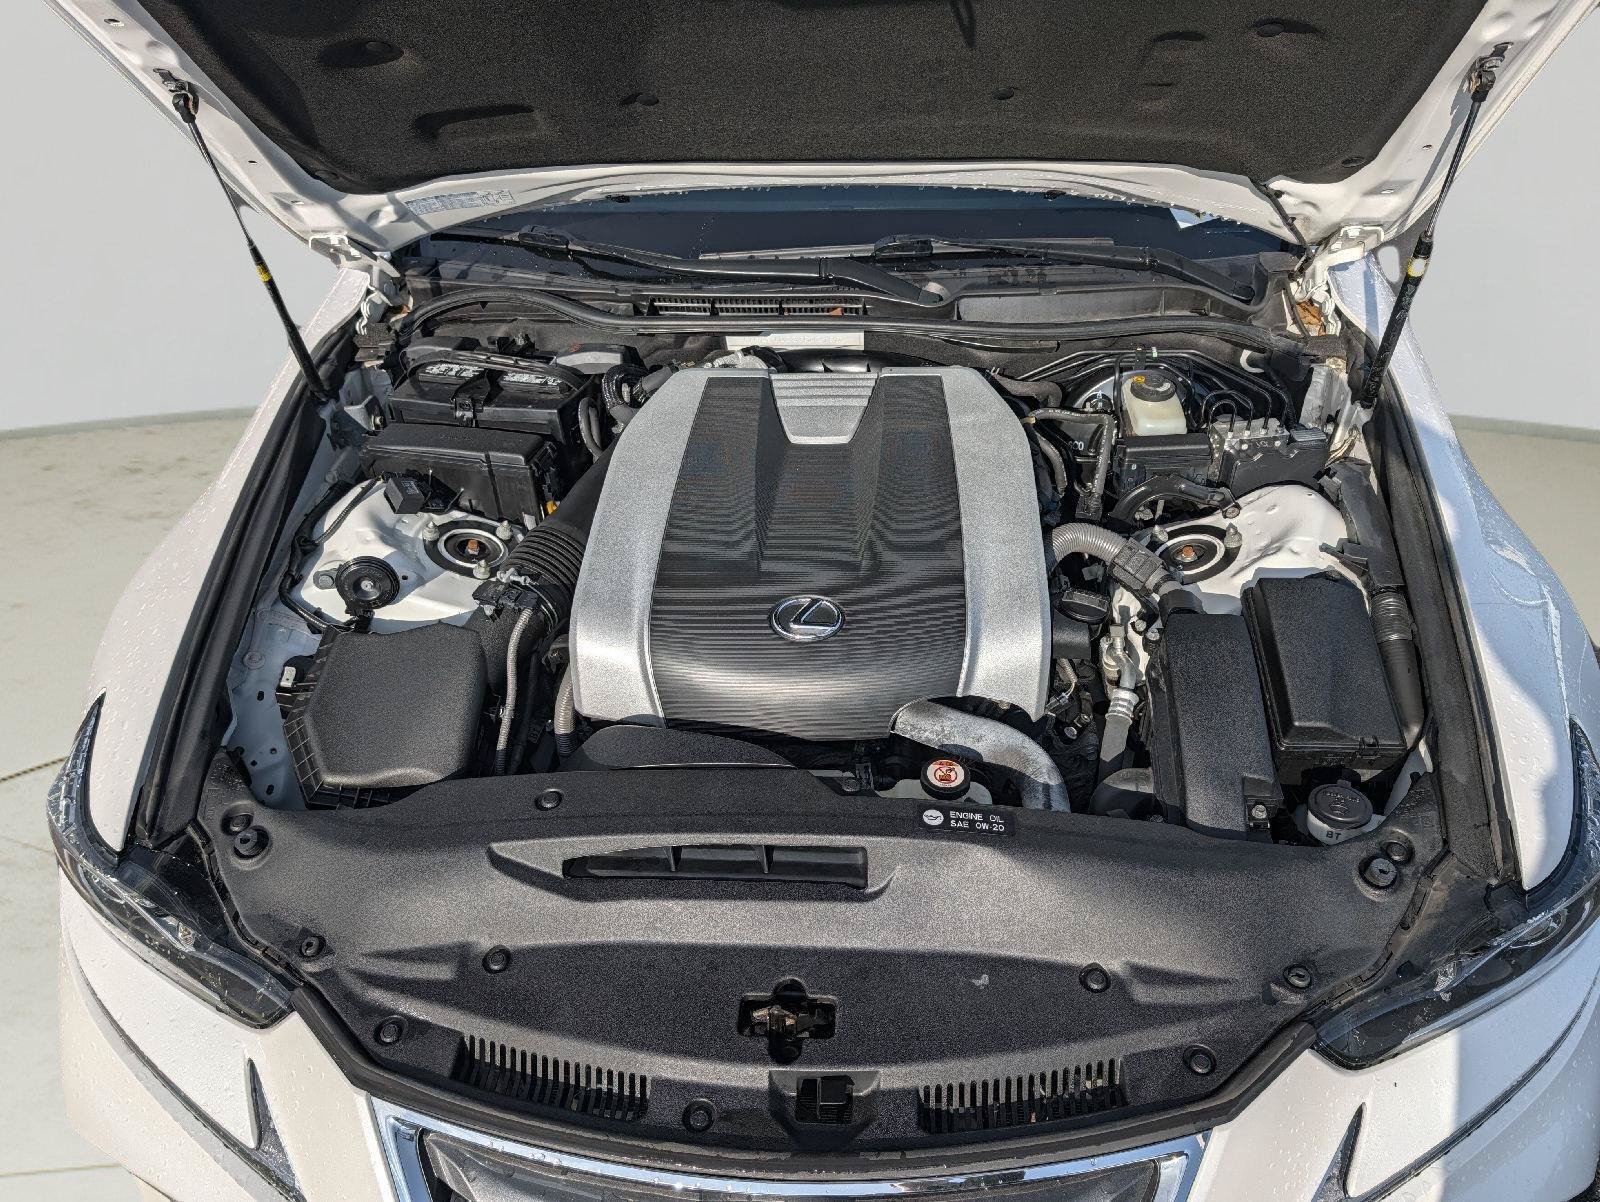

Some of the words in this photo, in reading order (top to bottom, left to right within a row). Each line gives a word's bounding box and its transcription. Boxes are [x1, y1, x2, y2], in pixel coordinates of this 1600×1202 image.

[949, 811, 983, 820] ENGINE
[989, 815, 1005, 823] OIL
[950, 820, 969, 828] SAE
[975, 822, 1005, 831] 0W-20
[1326, 831, 1341, 840] BT
